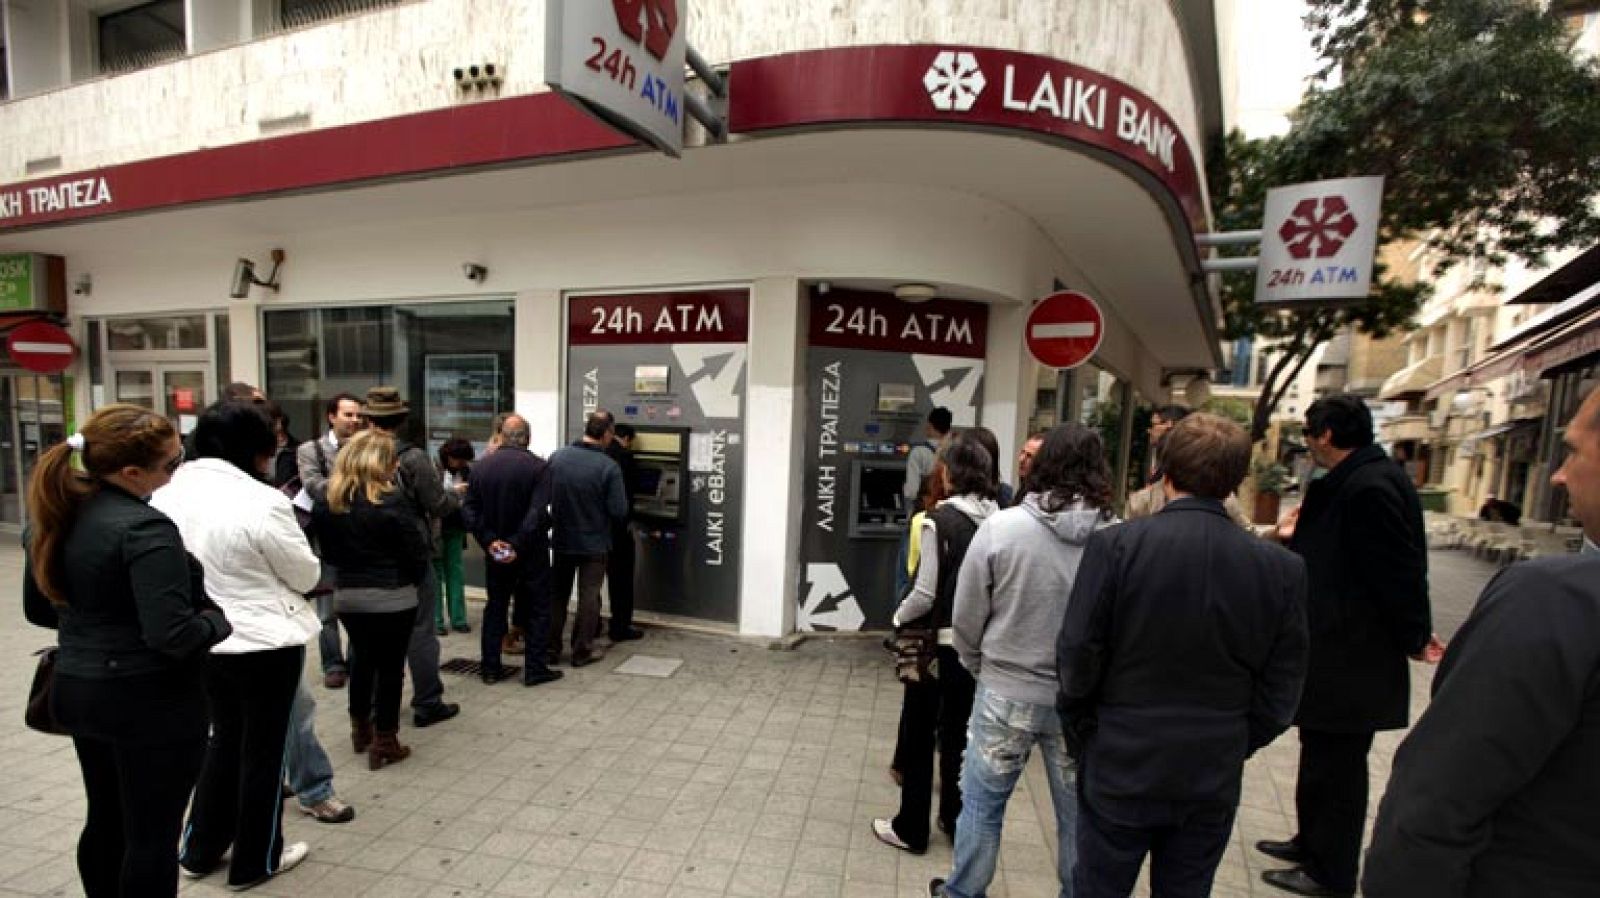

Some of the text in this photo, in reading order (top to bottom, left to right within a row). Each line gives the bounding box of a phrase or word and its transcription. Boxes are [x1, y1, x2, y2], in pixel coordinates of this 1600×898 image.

[585, 37, 678, 126] 24h ATM
[1003, 65, 1176, 172] LAIKI BANK
[27, 177, 112, 213] ΤΡΑΠΕΖΑ
[1267, 266, 1357, 288] 24h ATM
[590, 304, 724, 335] 24h ATM
[825, 304, 974, 345] 24h ATM
[582, 367, 600, 424] ΠΕΖΑ
[818, 360, 842, 459] ΤΡΑΠΕΖΑ
[706, 428, 727, 566] LAIKI eBANK
